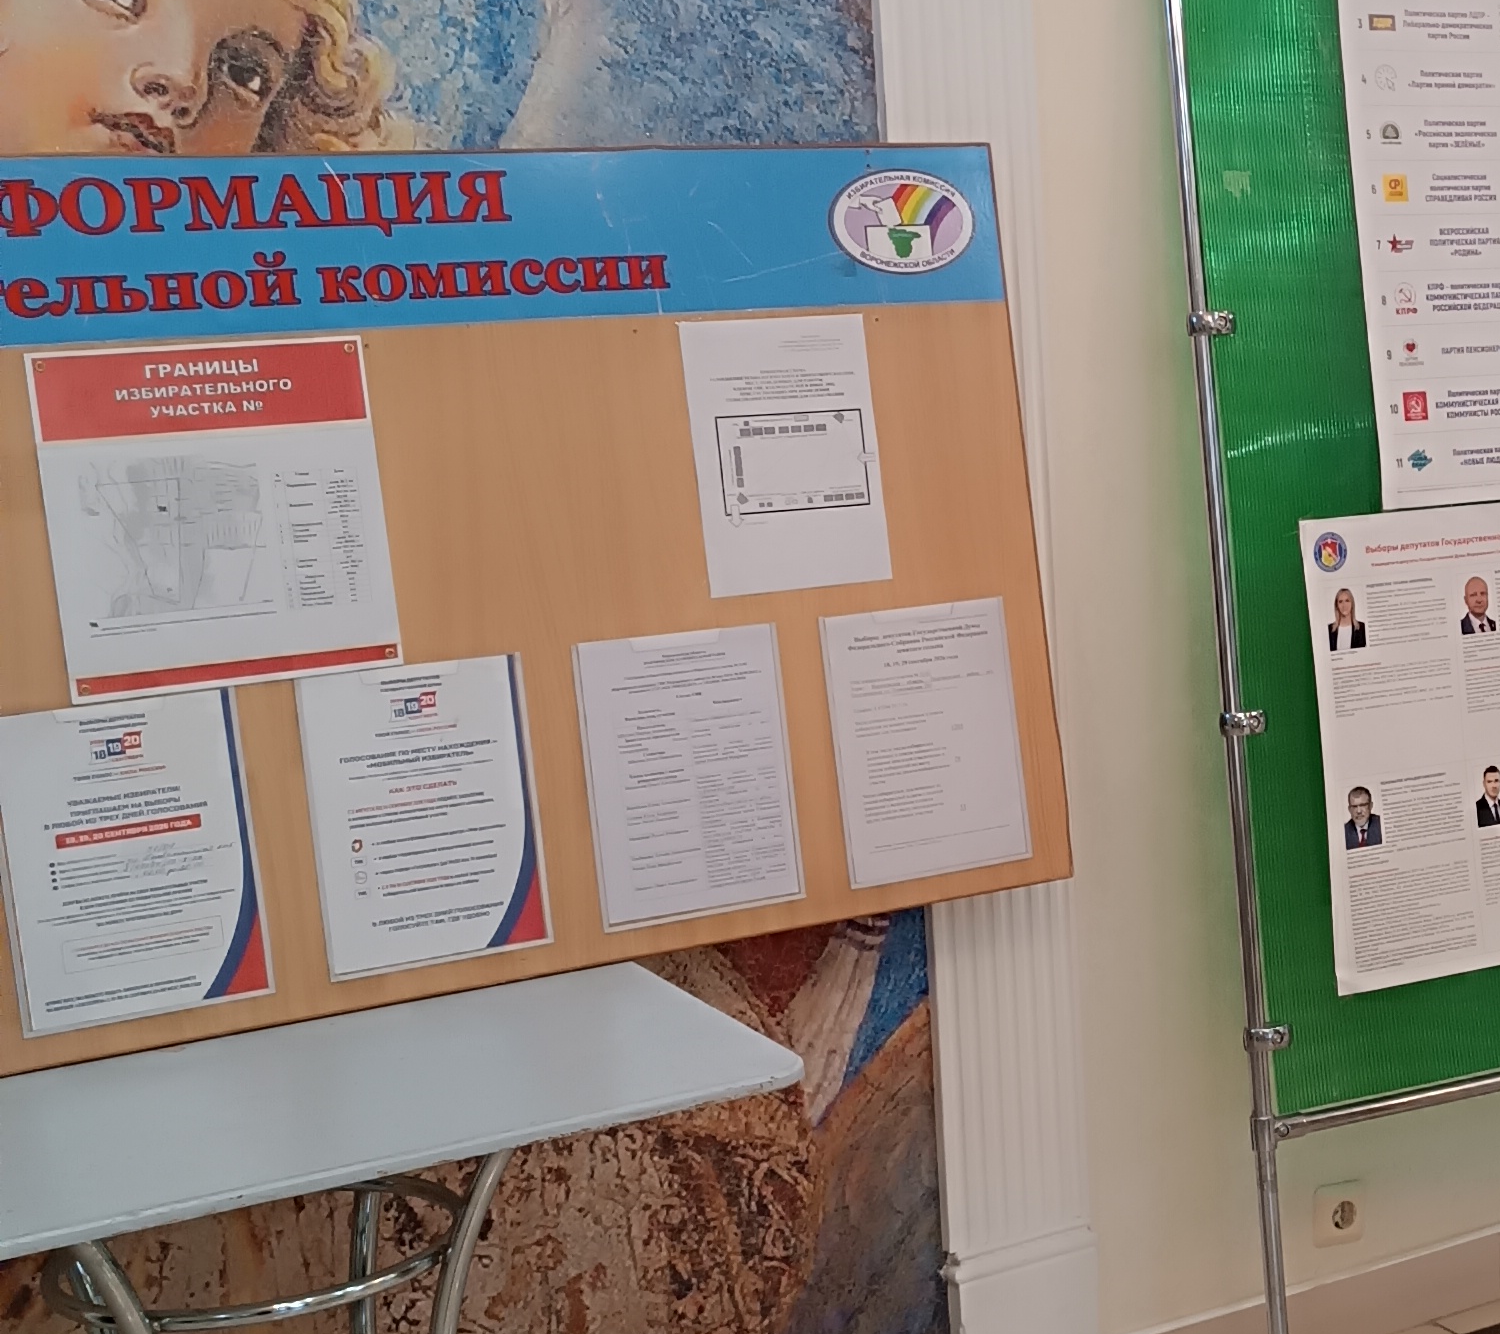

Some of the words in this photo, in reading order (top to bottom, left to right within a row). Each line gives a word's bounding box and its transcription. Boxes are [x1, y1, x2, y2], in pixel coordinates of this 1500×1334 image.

[1366, 129, 1371, 140] 5
[846, 175, 910, 199] ИЗБИРАТЕЛЬНАЯ
[0, 170, 512, 237] ФОРМАЦИЯ
[860, 251, 920, 268] ВОРОНЕЖСКОЙ
[922, 248, 955, 267] ОБЛАСТИ
[0, 251, 301, 317] ельной
[316, 253, 670, 306] комиссии
[1386, 350, 1392, 360] 9
[145, 358, 258, 379] ГРАНИЦЫ
[115, 378, 292, 401] ИЗБИРАТЕЛЬНОГО
[151, 401, 236, 418] УЧАСТКА
[243, 400, 263, 413] №
[1390, 404, 1398, 414] 10
[1436, 400, 1499, 408] КОММУНИСТИЧЕСКАЯ
[1447, 409, 1489, 418] КОММУНИСТЫ
[1365, 543, 1398, 554] Выборы
[1400, 538, 1439, 552] депутатов
[406, 702, 418, 711] 19
[420, 695, 434, 705] 20
[93, 750, 106, 760] 18
[108, 743, 121, 753] 19
[124, 736, 139, 746] 20
